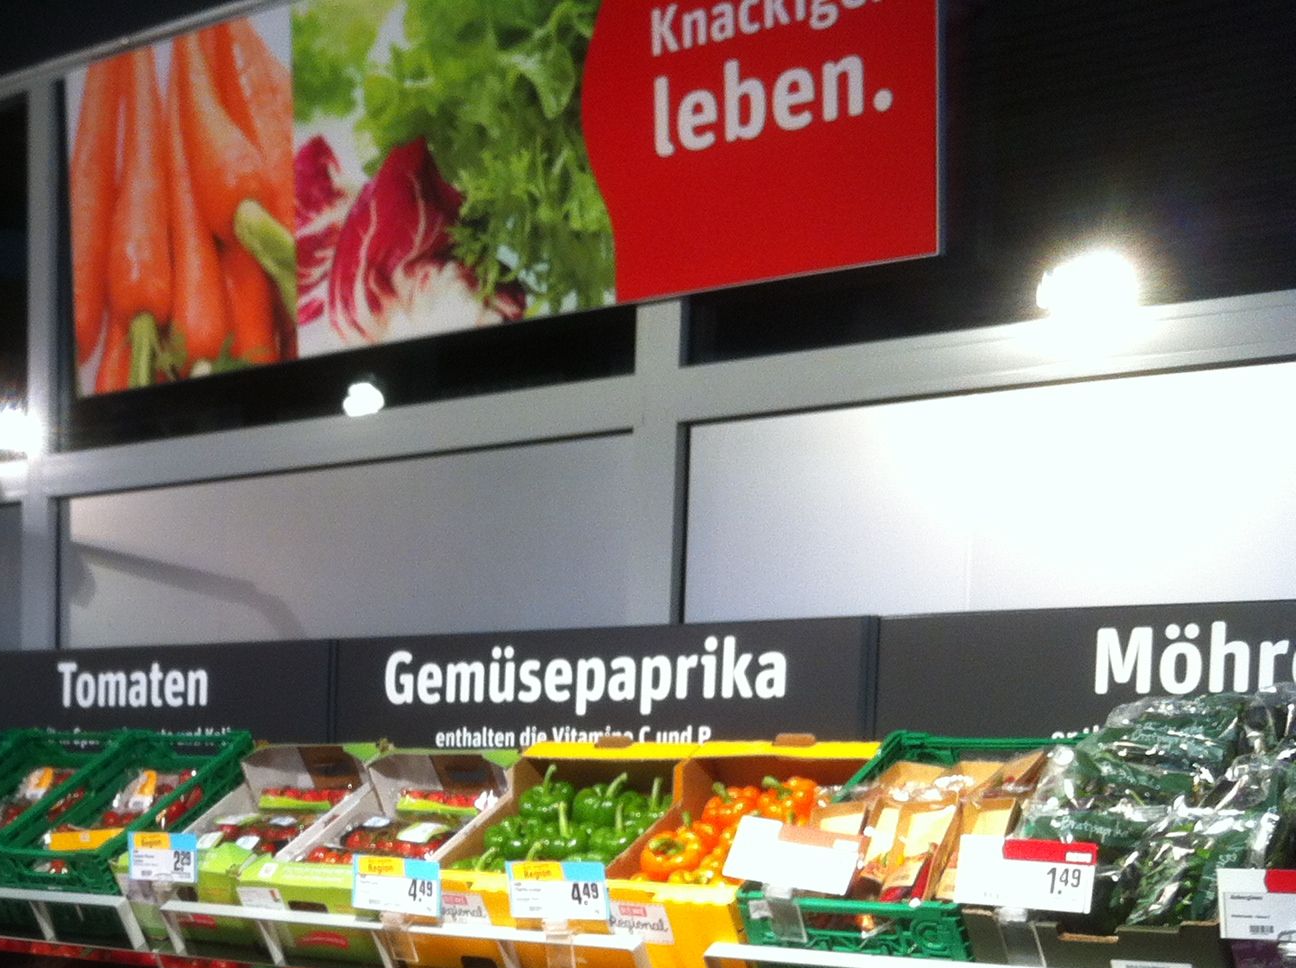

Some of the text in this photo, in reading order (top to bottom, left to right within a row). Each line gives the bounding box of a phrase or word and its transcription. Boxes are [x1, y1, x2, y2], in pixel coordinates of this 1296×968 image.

[651, 0, 882, 57] Knackig
[653, 54, 893, 158] leben.
[384, 636, 788, 716] Gemüsepaprika
[1094, 620, 1296, 695] Möhr
[57, 661, 208, 709] Tomaten
[435, 726, 515, 749] enthalten
[519, 726, 547, 746] die
[552, 726, 633, 746] Vitam
[639, 726, 651, 745] C
[656, 725, 692, 745] und
[1046, 867, 1082, 895] 1.49
[442, 905, 485, 921] egional
